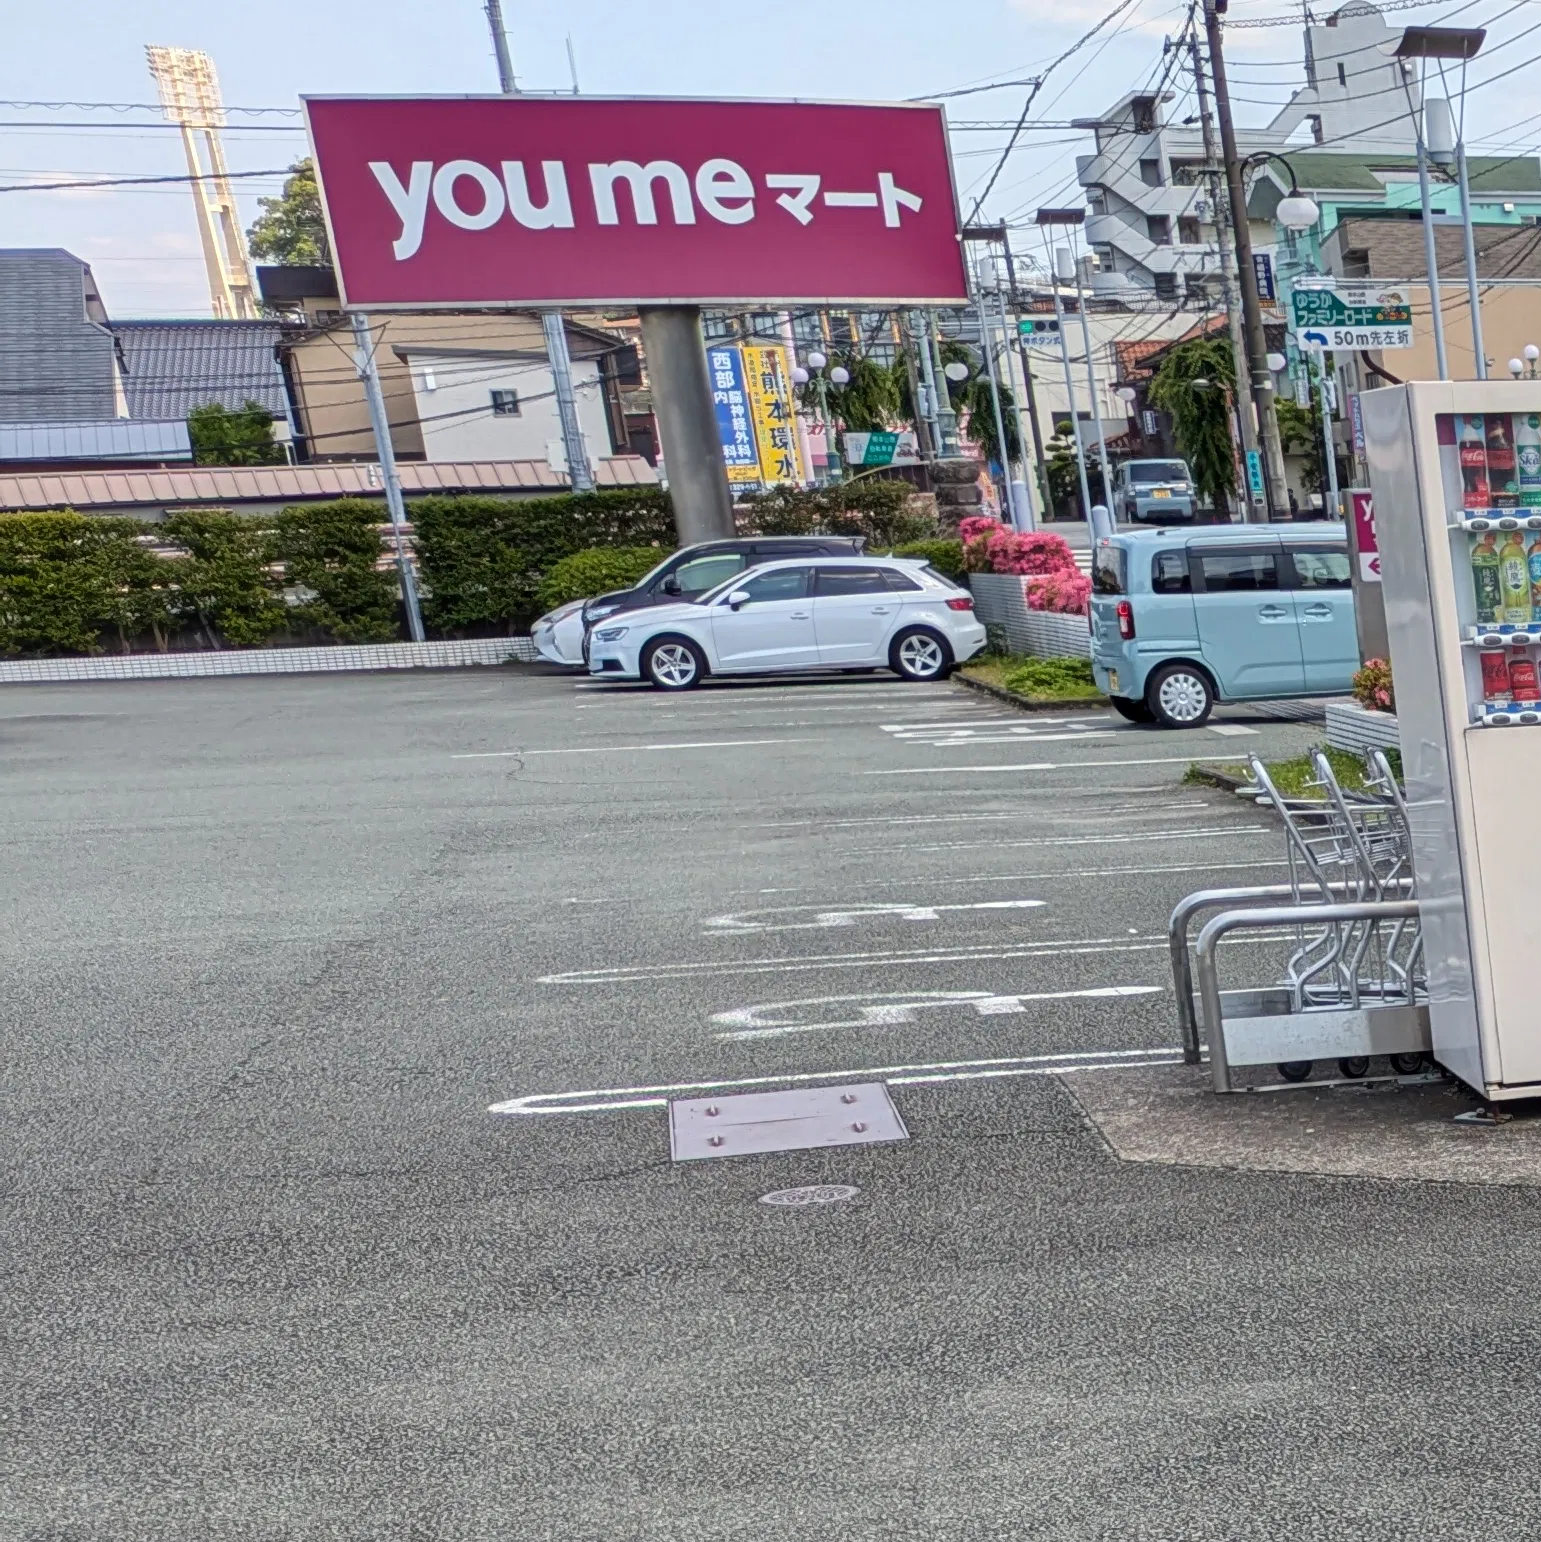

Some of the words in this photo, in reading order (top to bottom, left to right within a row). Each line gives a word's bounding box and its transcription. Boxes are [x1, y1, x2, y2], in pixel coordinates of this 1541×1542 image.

[368, 159, 575, 261] you
[588, 158, 756, 225] me
[766, 172, 924, 228] マート
[1296, 292, 1333, 309] ゆうか
[1297, 309, 1373, 326] ファミリーロード
[1334, 330, 1409, 346] 50m先左折
[712, 352, 735, 389] 西部
